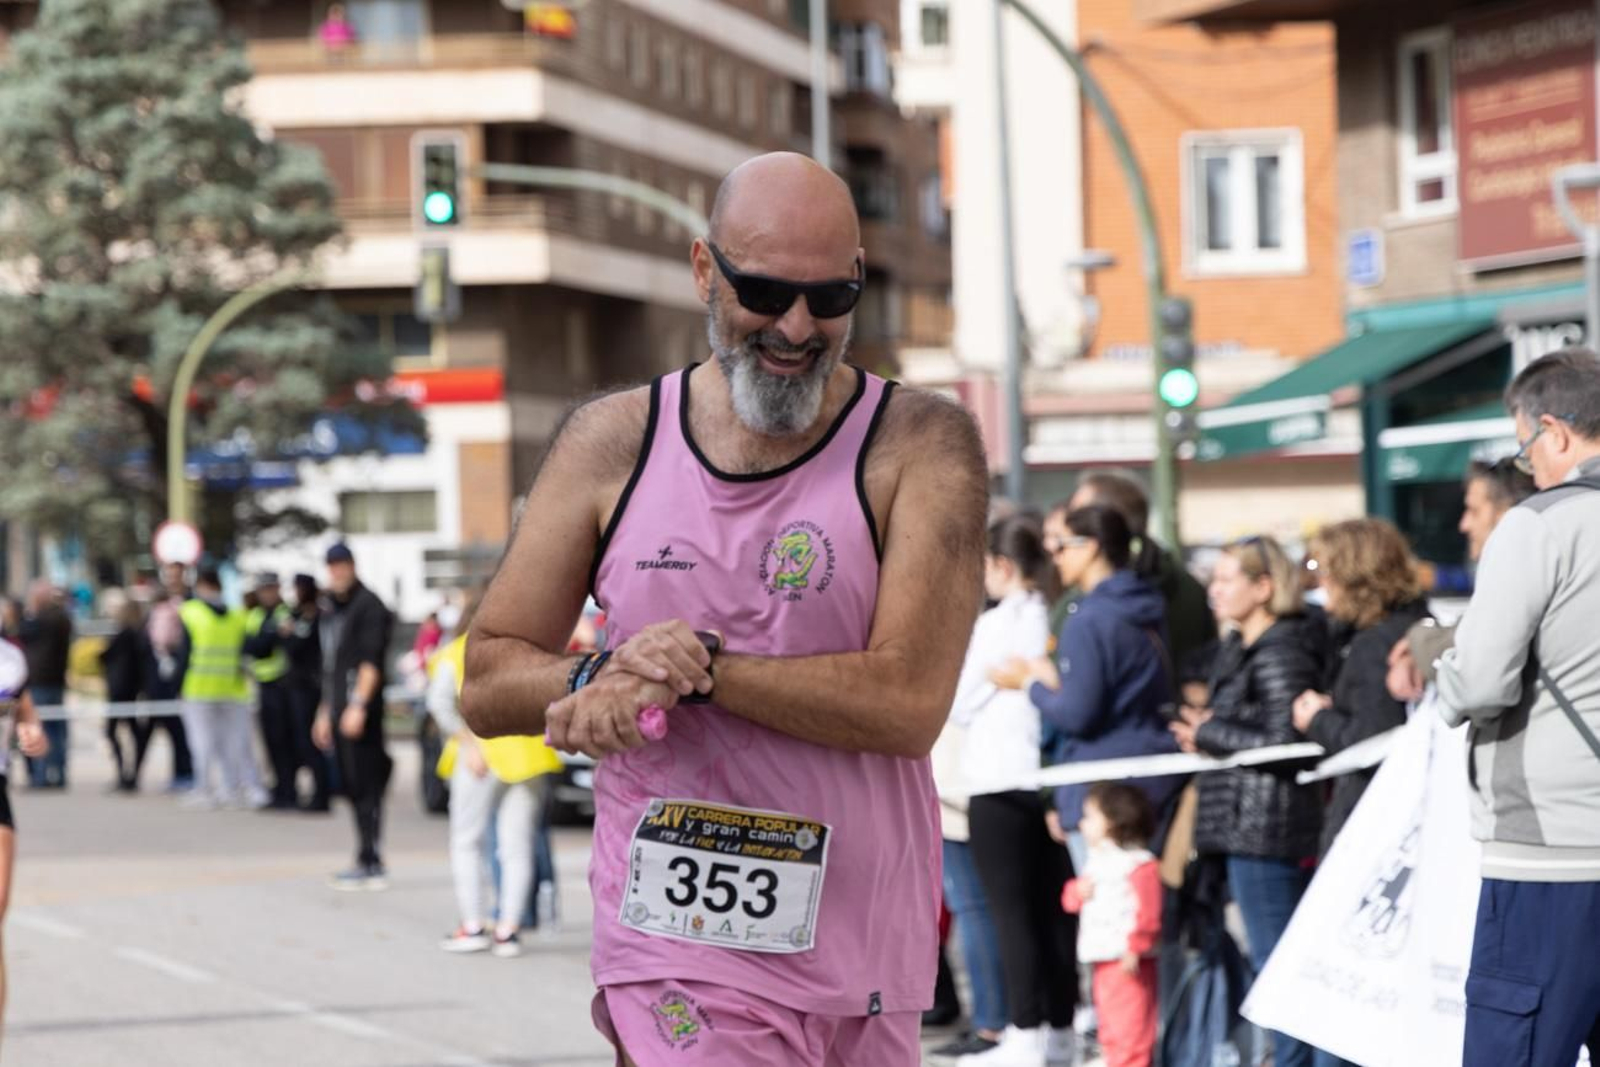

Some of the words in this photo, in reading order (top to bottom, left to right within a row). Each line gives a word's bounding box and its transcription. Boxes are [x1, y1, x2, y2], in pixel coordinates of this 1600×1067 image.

[815, 537, 836, 595] MARATON
[687, 807, 752, 828] CARRERA
[702, 822, 740, 837] gran
[748, 829, 795, 844] camin
[665, 856, 779, 919] 353
